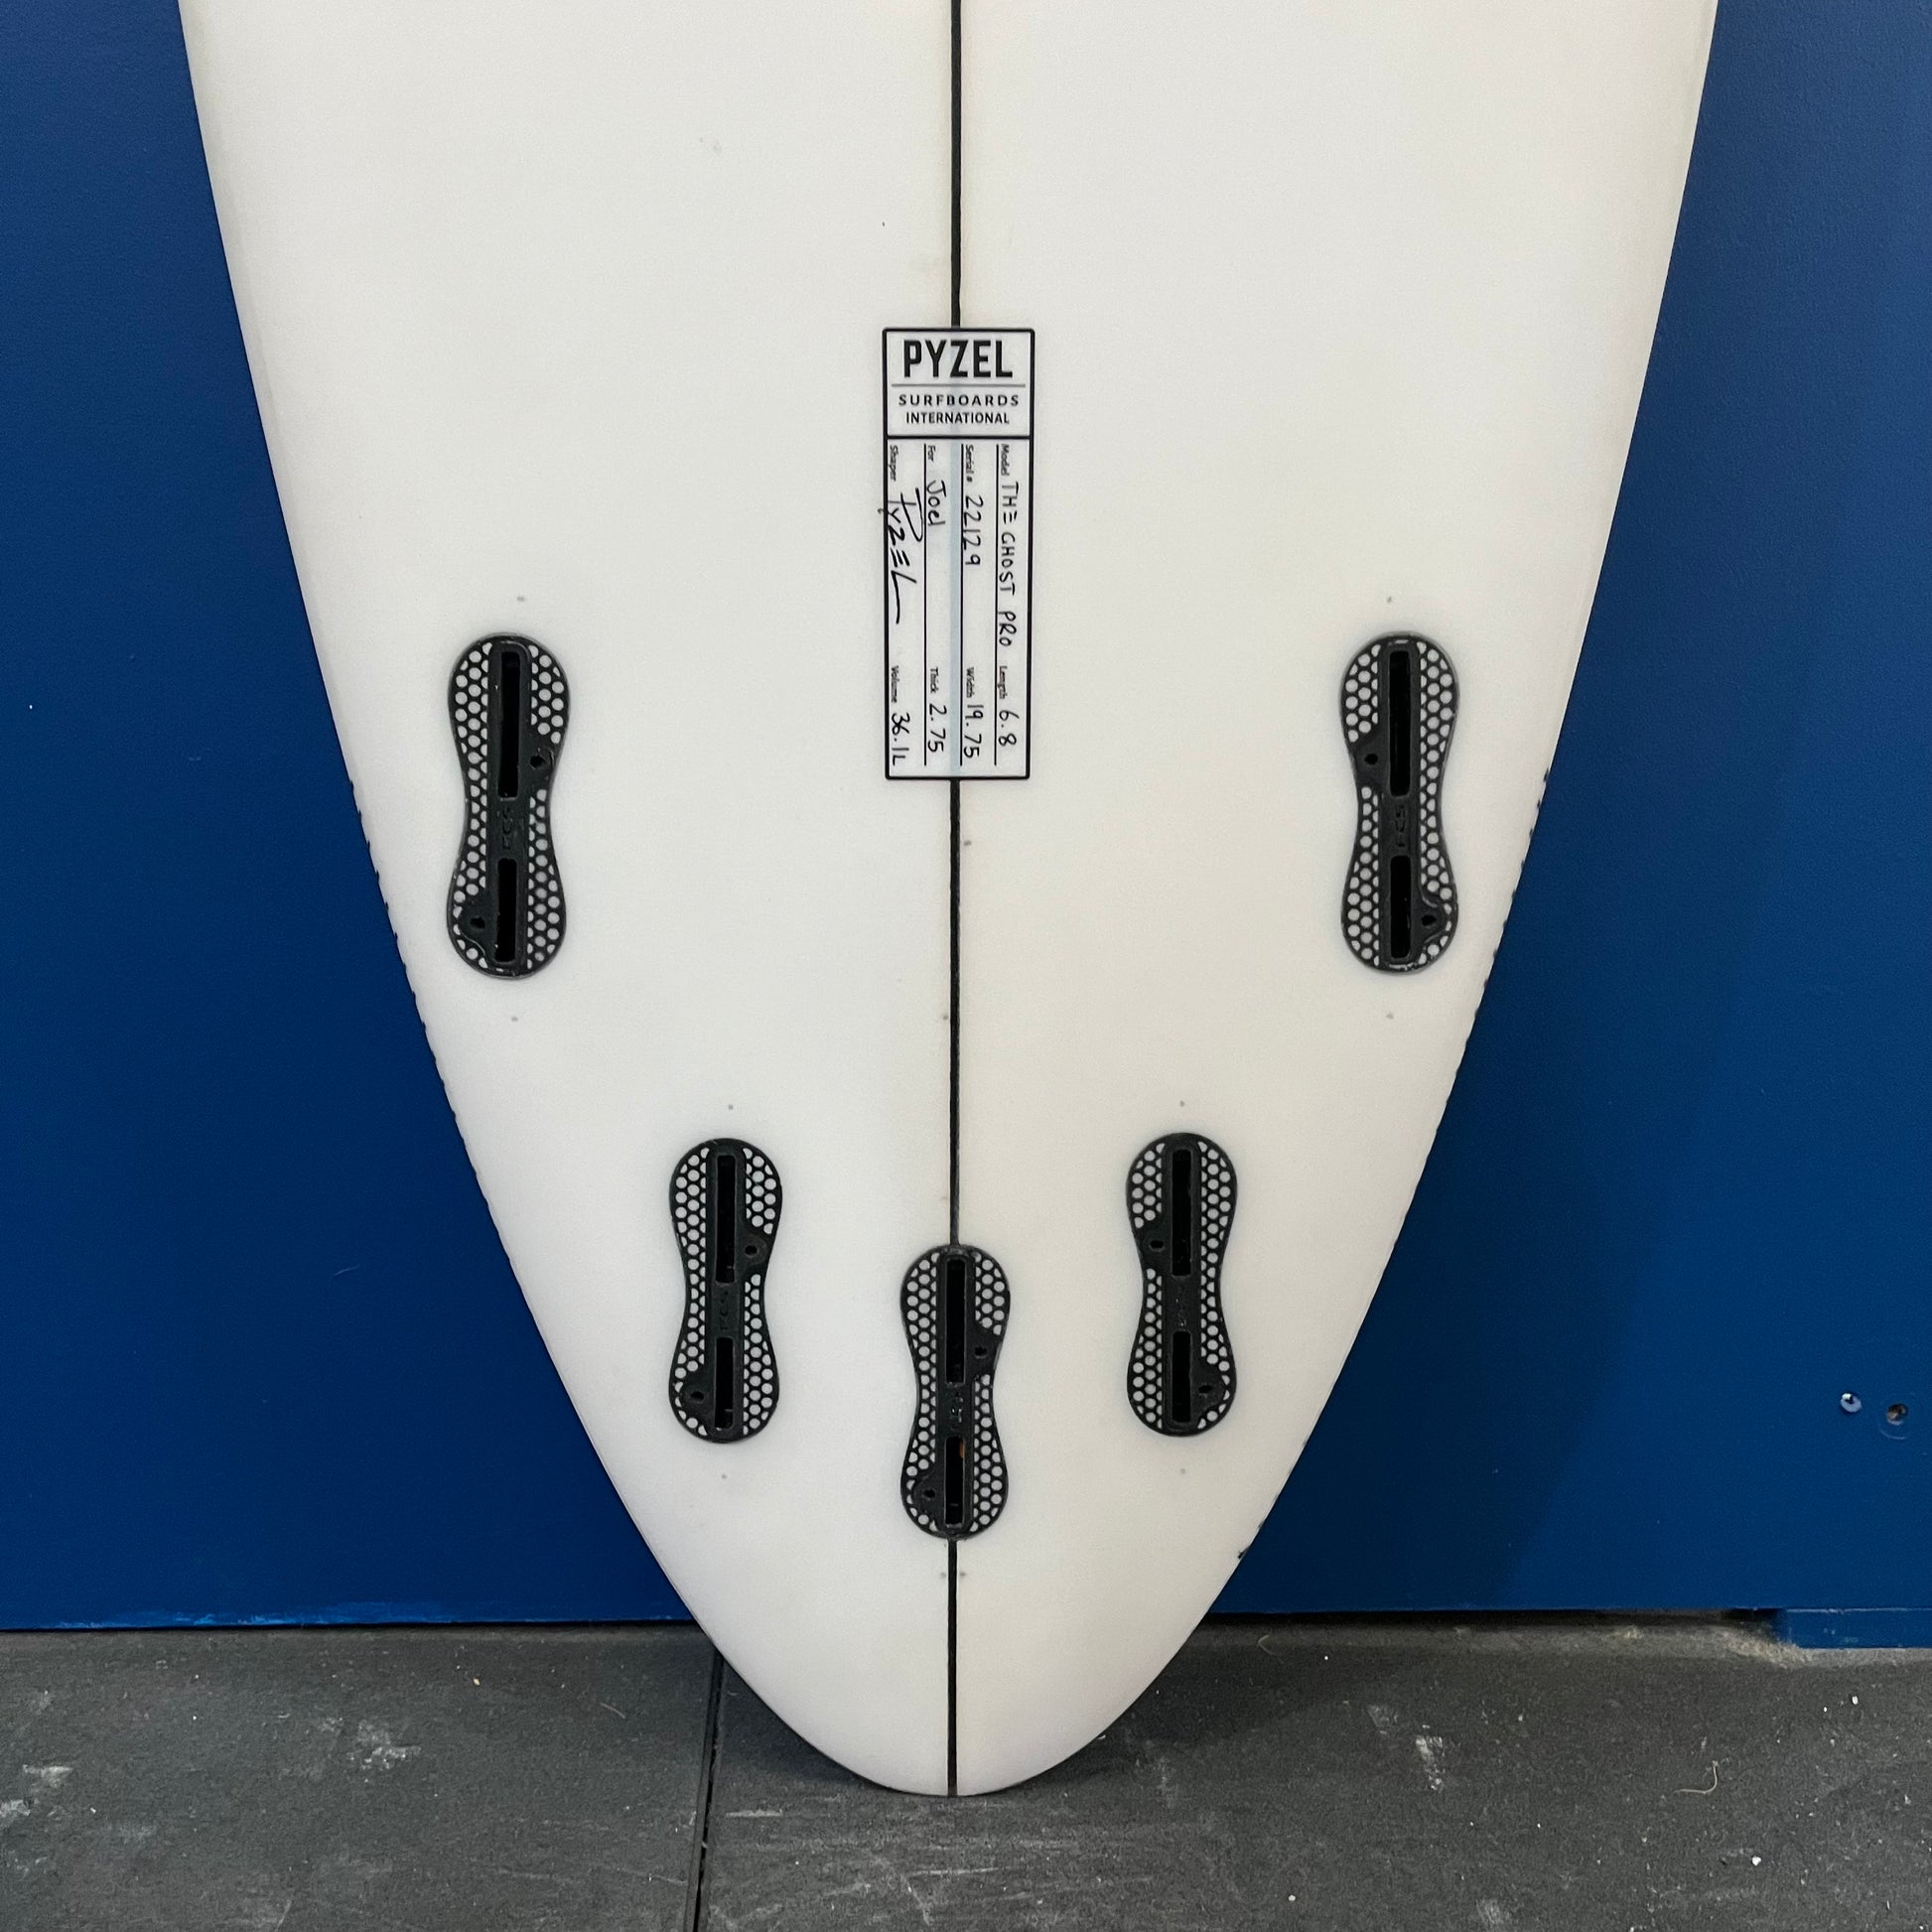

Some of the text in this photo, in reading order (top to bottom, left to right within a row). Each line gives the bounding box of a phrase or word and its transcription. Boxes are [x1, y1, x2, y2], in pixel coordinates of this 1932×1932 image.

[903, 340, 1013, 378] PYZEL
[897, 394, 1020, 407] SURFBOARDS
[905, 411, 1010, 425] INTERNATIONAL
[889, 445, 899, 482] Shaper
[926, 445, 947, 527] For Joel
[962, 494, 984, 566] 22129
[997, 443, 1020, 647] Model THE GHOST PRO
[891, 665, 899, 704] Volume
[927, 666, 948, 754] Thick 2.75
[963, 666, 985, 759] Width 19.75
[997, 665, 1021, 747] Length 6.8
